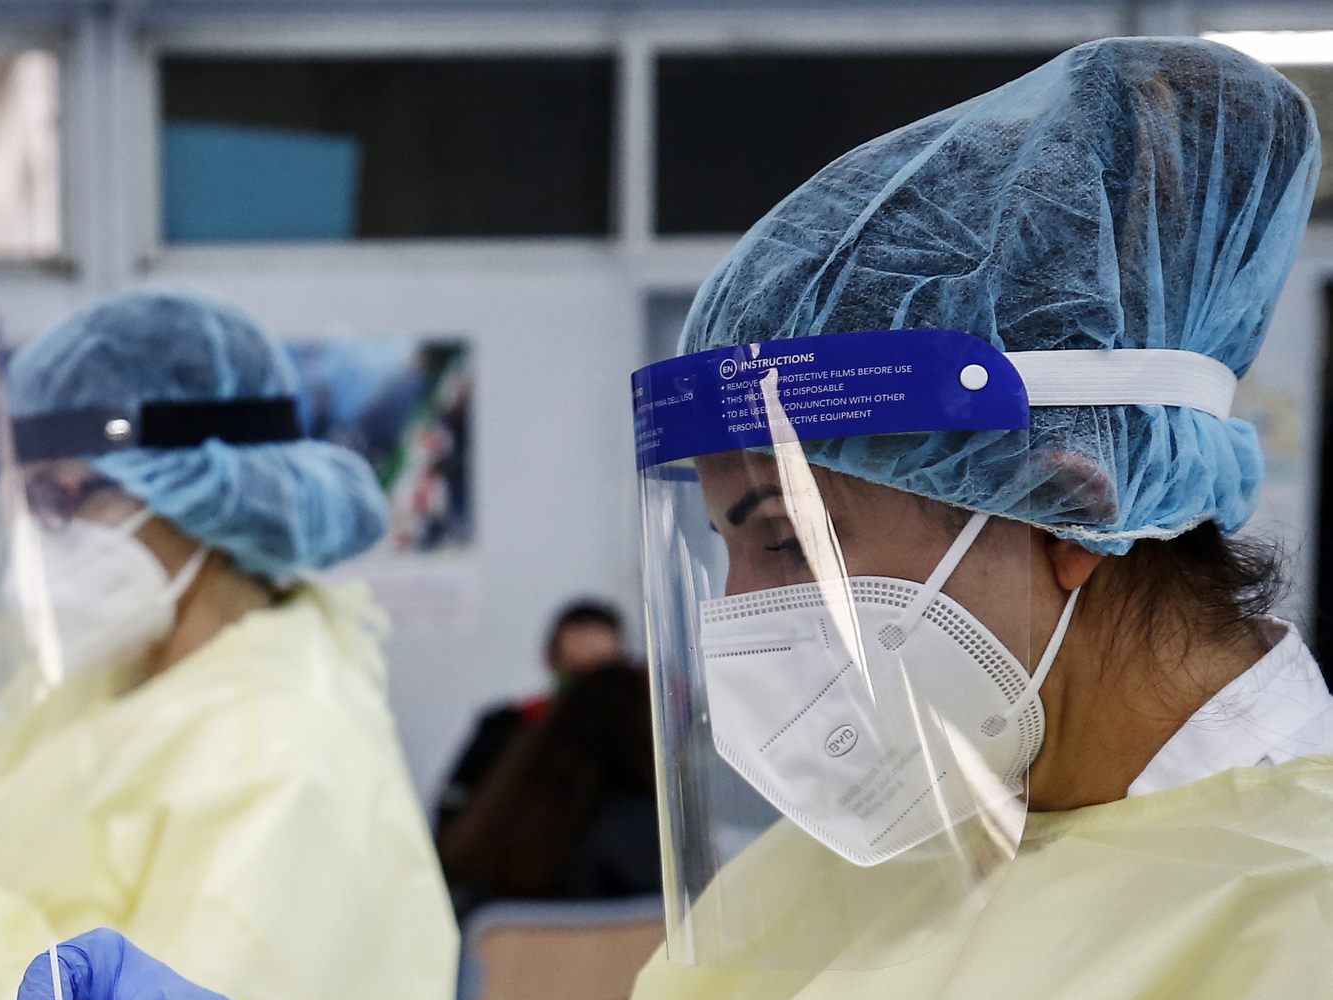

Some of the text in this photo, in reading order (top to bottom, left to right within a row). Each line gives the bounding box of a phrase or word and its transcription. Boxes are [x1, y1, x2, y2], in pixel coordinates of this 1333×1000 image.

[722, 352, 815, 374] EN INSTRUCTIONS
[727, 380, 758, 390] REMOVE
[778, 371, 828, 384] PROTECTIVE
[830, 368, 856, 378] FILMS
[858, 366, 893, 376] BEFORE
[895, 365, 912, 373] USE
[727, 395, 743, 404] THIS
[784, 388, 791, 397] IS
[792, 383, 844, 395] DISPOSABLE
[727, 410, 737, 418] TO
[739, 409, 749, 417] BE
[784, 397, 847, 411] CONJUNCTION
[849, 395, 872, 404] WITH
[874, 393, 905, 402] OTHER
[728, 421, 767, 433] PERSONAL
[820, 409, 872, 422] EQUIPMENT
[828, 728, 854, 753] BYD
